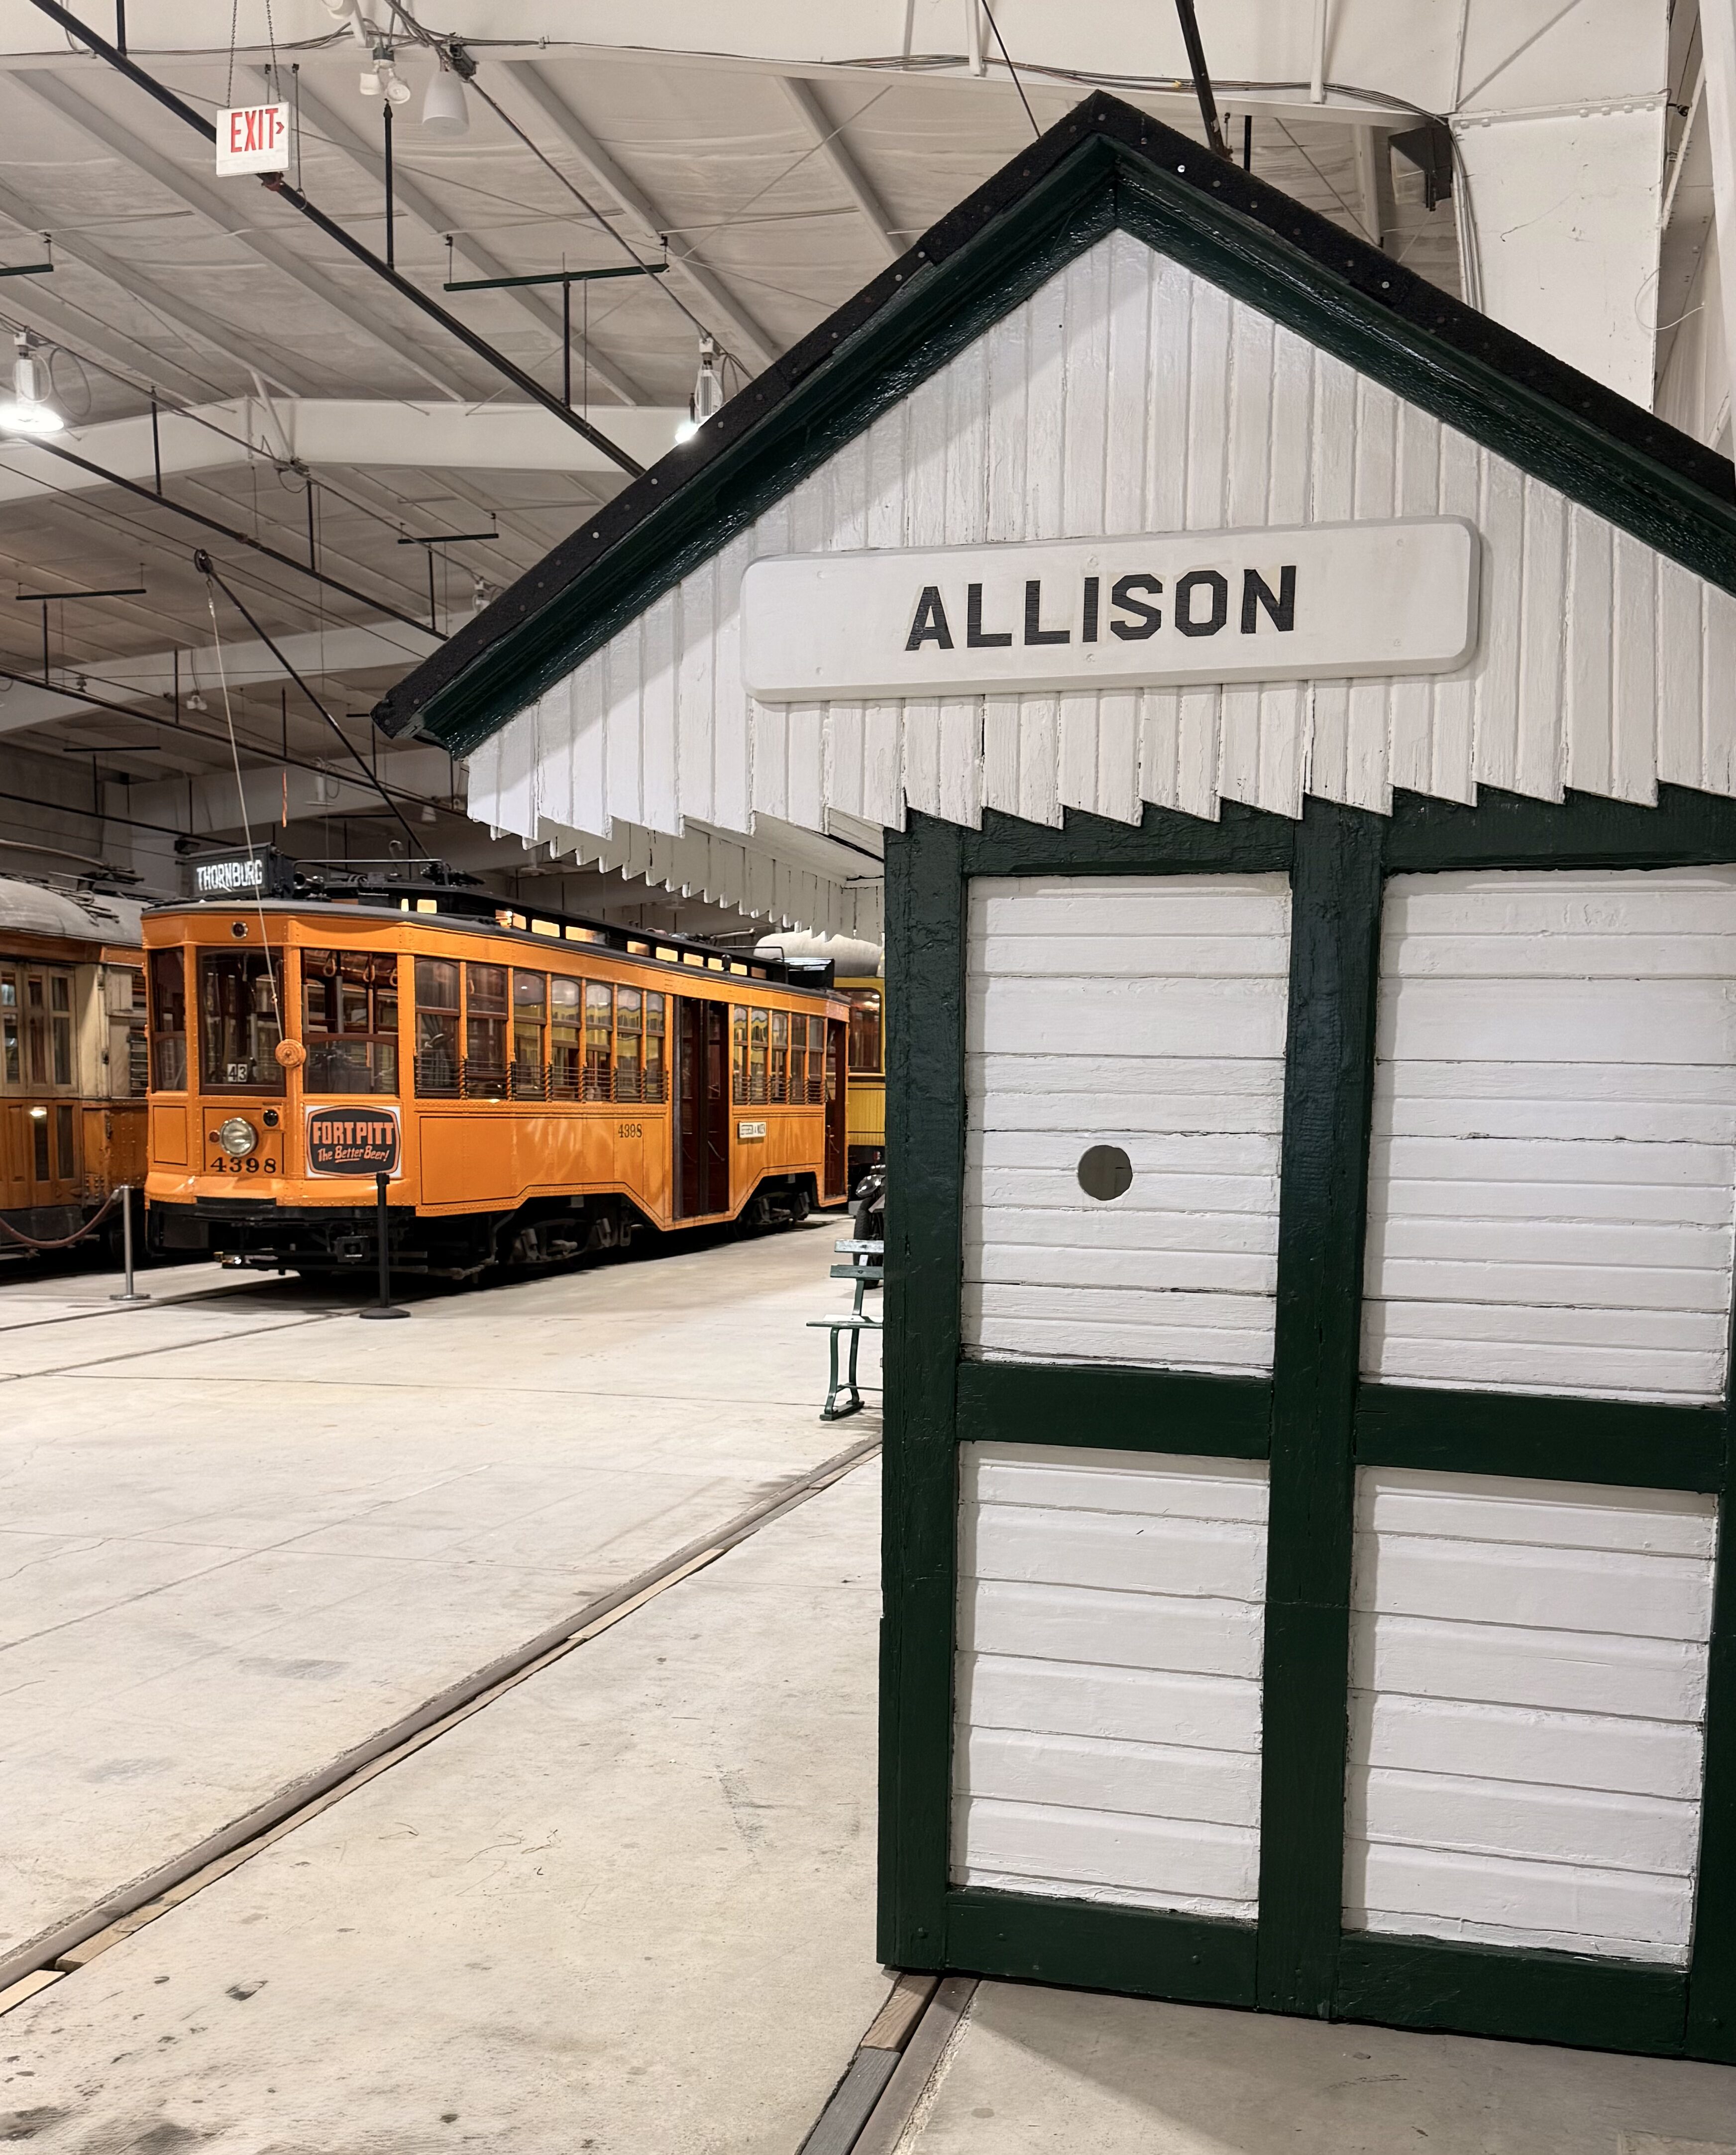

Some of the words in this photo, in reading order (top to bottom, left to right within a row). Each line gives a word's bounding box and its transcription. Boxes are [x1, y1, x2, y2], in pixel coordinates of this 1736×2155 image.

[231, 108, 279, 153] EXIT
[904, 565, 1297, 651] ALLISON
[196, 859, 263, 891] THORNBURG
[229, 1066, 246, 1081] 43
[313, 1122, 354, 1144] FORT
[356, 1122, 394, 1144] PITT
[618, 1124, 643, 1138] 4398
[318, 1147, 333, 1162] The
[334, 1145, 364, 1161] Better
[364, 1145, 390, 1162] Beer!
[210, 1156, 276, 1173] 4398
